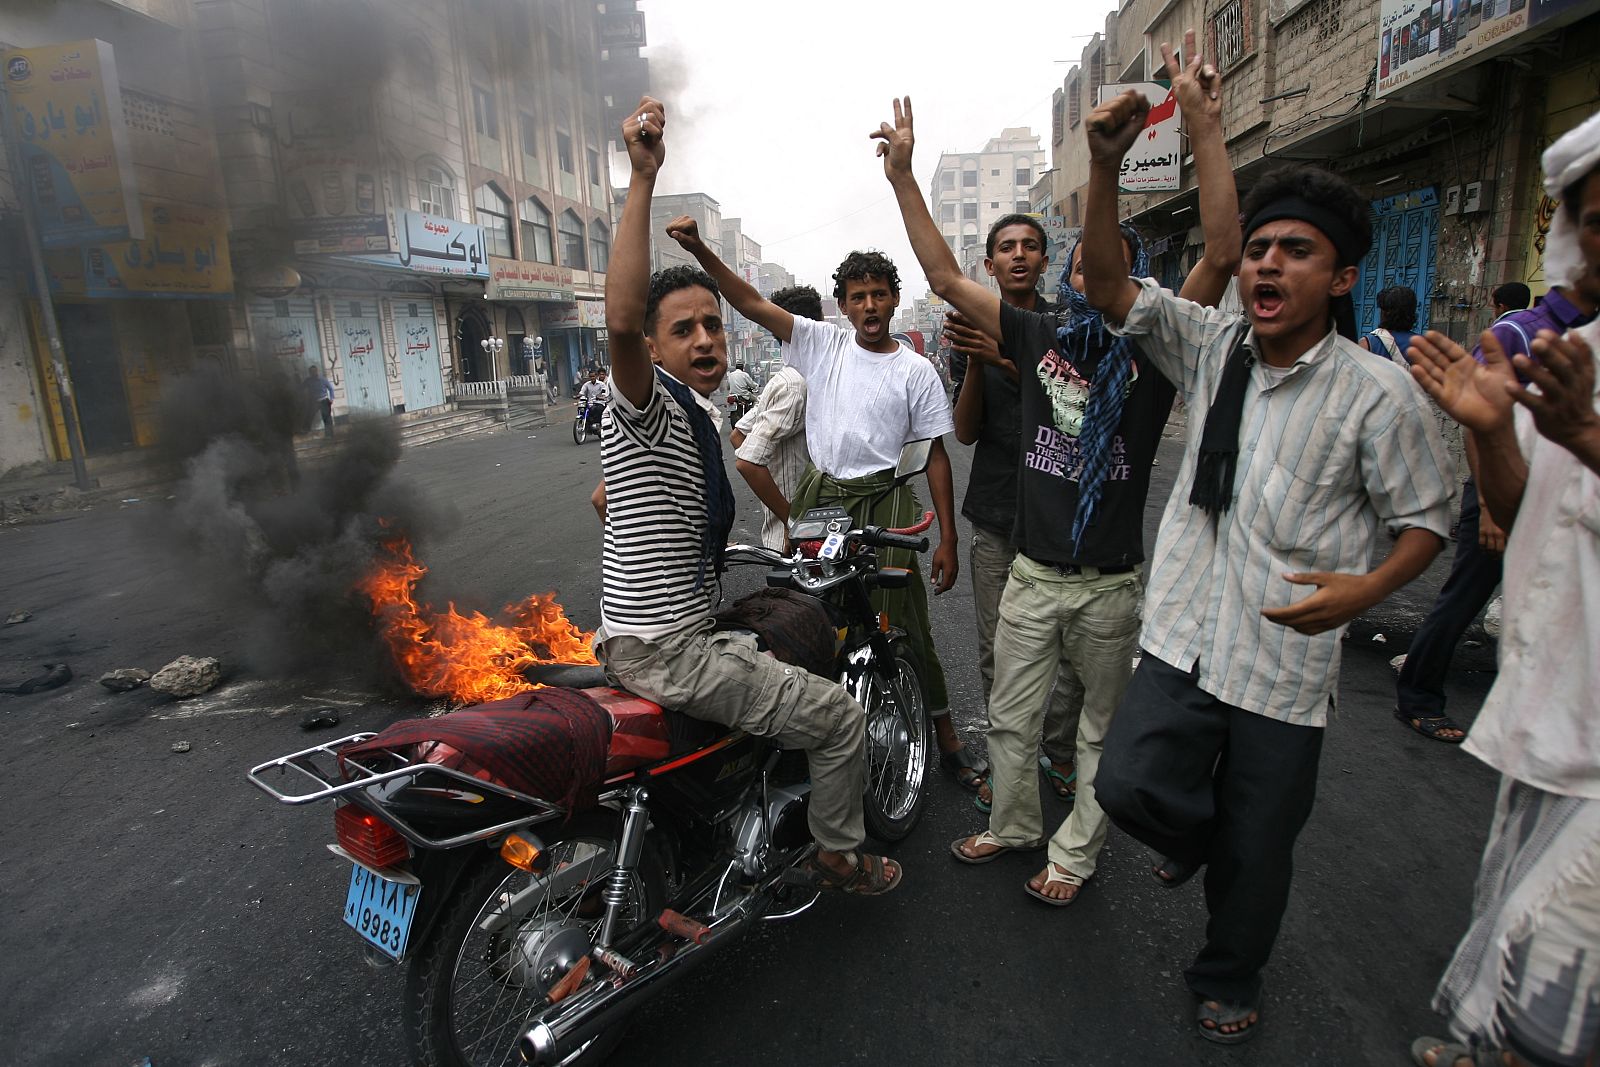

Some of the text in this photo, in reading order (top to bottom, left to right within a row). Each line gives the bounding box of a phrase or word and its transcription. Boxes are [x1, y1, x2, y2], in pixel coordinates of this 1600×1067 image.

[400, 212, 488, 274] الوكيل
[424, 220, 449, 237] مجموعة
[361, 907, 401, 952] 9983
